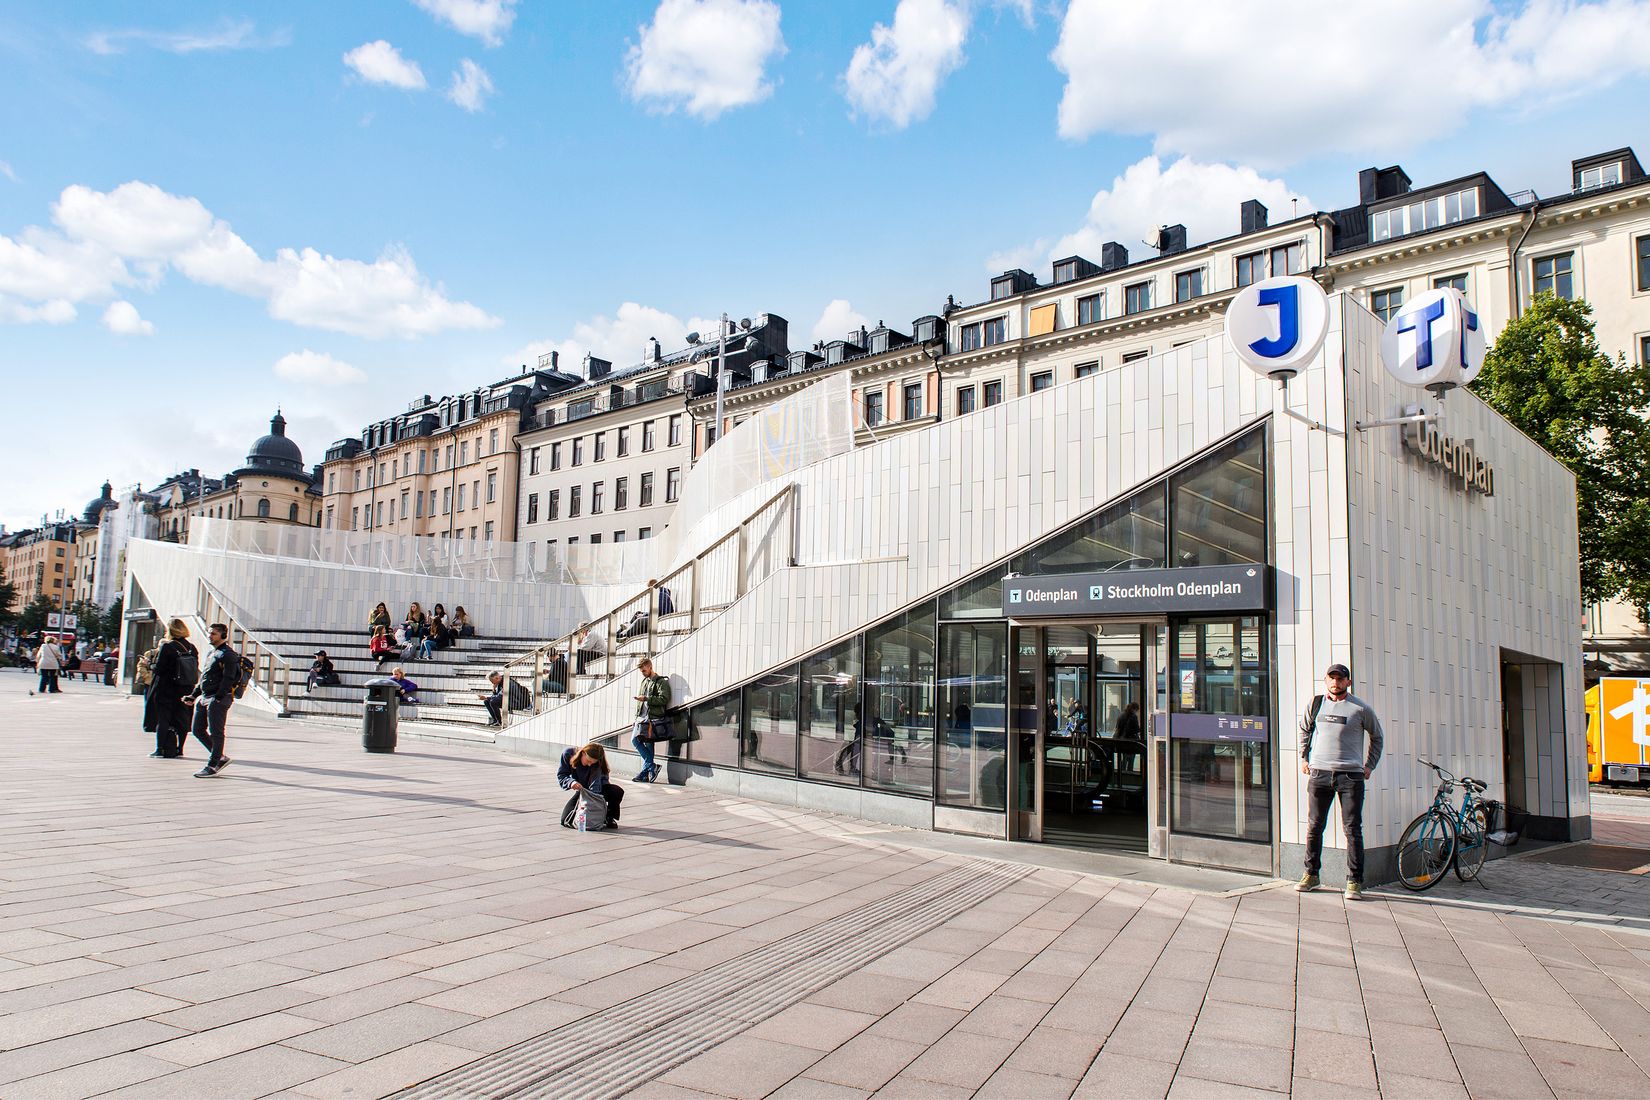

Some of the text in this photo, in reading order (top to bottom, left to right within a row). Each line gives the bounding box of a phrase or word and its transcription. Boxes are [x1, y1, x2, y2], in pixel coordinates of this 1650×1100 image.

[1248, 284, 1299, 358] J
[1397, 296, 1445, 371] T
[1414, 405, 1496, 497] Odenplan
[1025, 588, 1078, 604] Odenplan
[1107, 580, 1242, 599] Stockholm Odenplan
